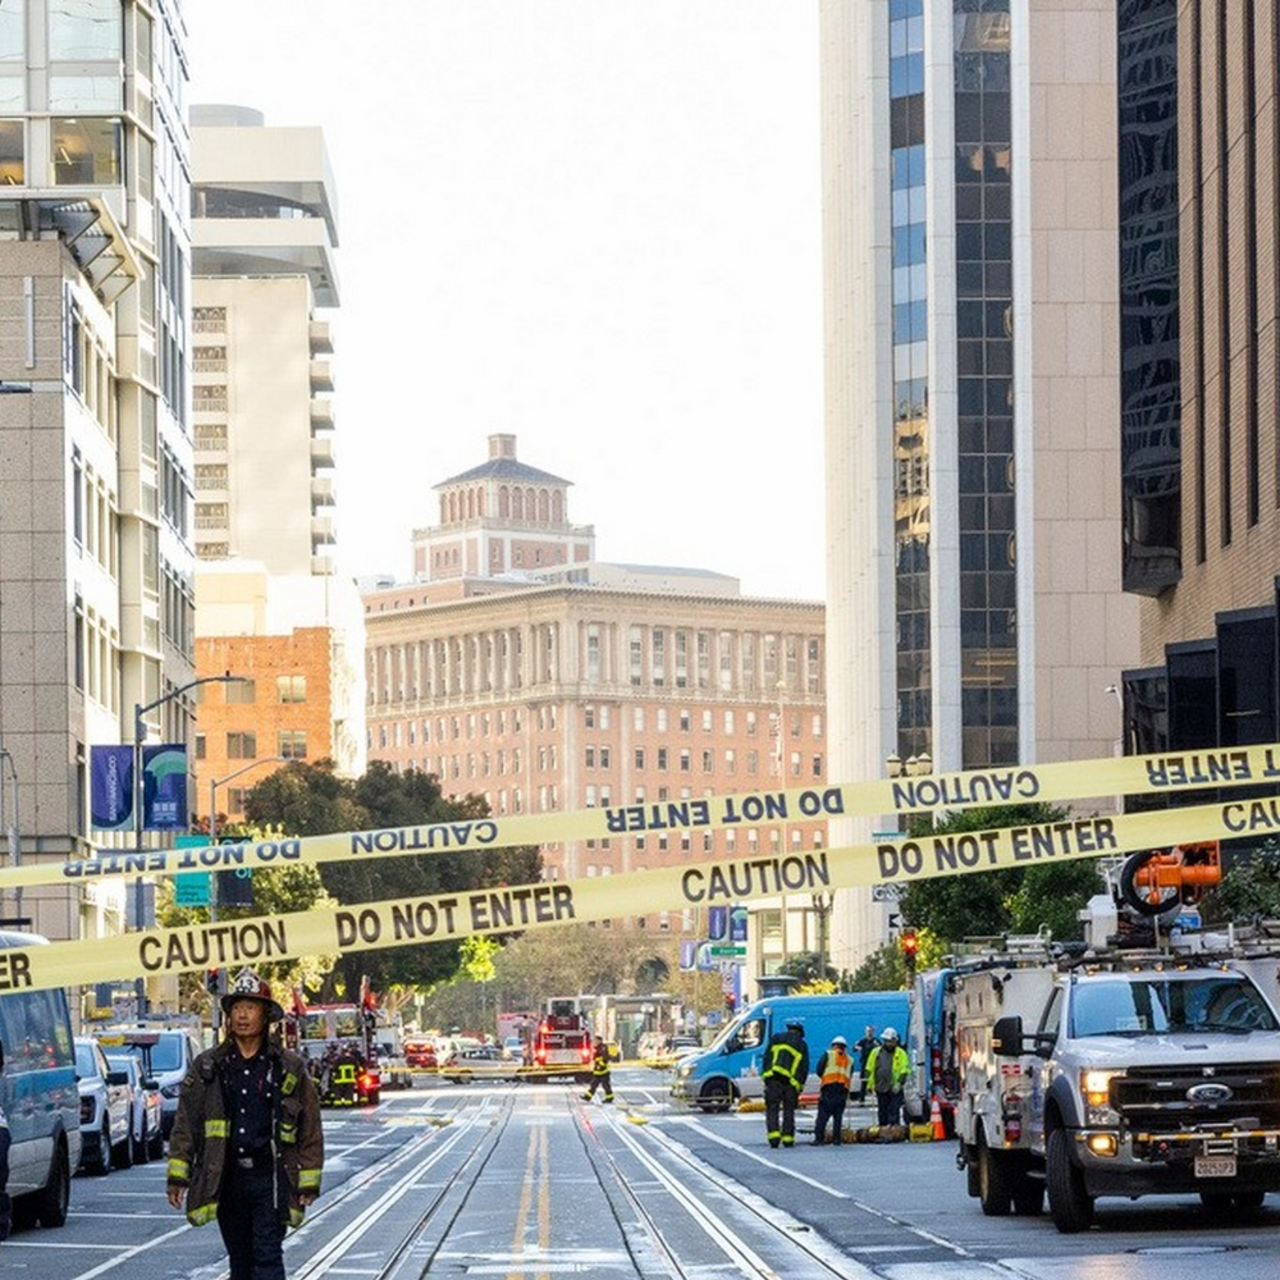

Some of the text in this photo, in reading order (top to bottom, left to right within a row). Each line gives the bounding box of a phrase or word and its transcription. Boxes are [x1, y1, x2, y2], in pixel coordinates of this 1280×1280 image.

[894, 771, 1039, 808] CAUTION
[1146, 751, 1251, 787] ENTER
[606, 787, 844, 832] DO NOT ENTER
[64, 839, 300, 877] DO NOT ENTER
[352, 821, 498, 854] CAUTION
[877, 818, 1118, 878] DO NOT ENTER
[682, 853, 830, 902] CAUTION
[336, 885, 576, 947] DO NOT ENTER
[140, 920, 287, 970] CAUTION
